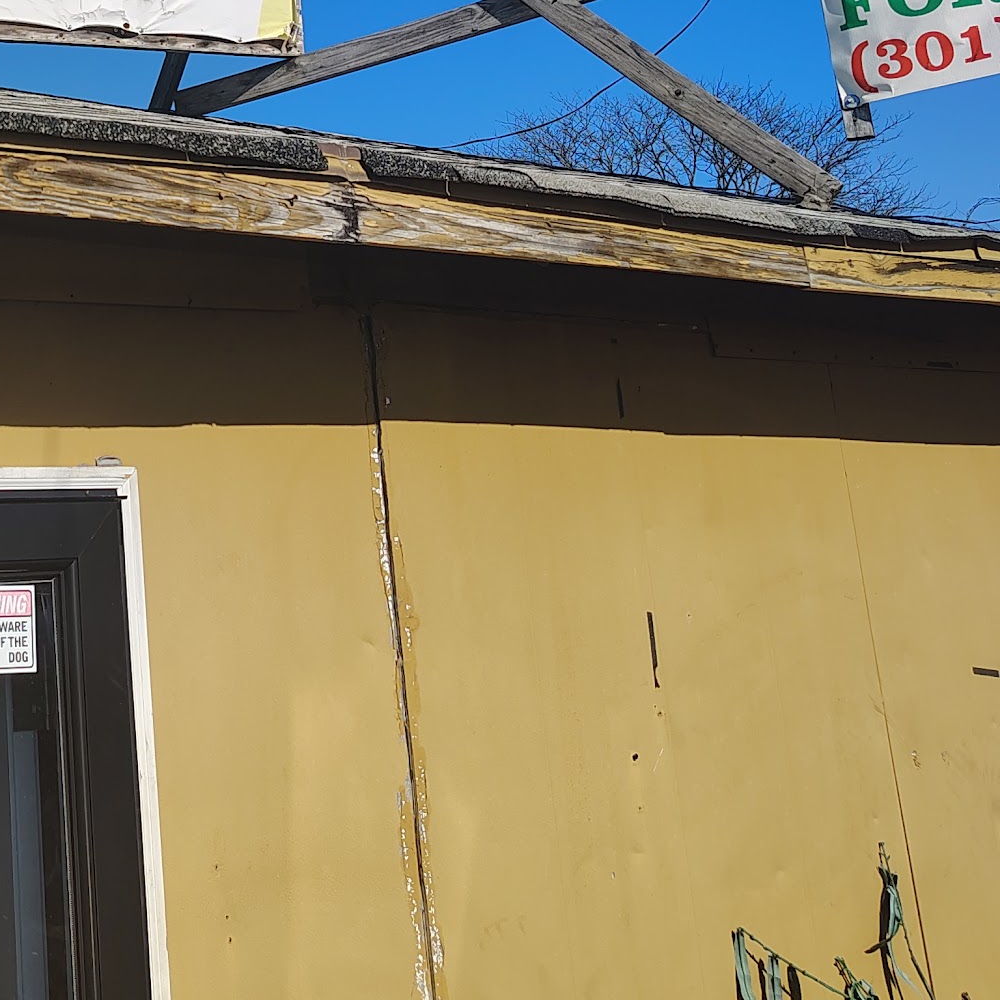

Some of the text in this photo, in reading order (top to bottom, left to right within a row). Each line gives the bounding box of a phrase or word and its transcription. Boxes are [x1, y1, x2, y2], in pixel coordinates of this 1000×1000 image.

[851, 16, 1000, 93] (301
[8, 636, 28, 648] THE
[9, 652, 29, 663] DOG
